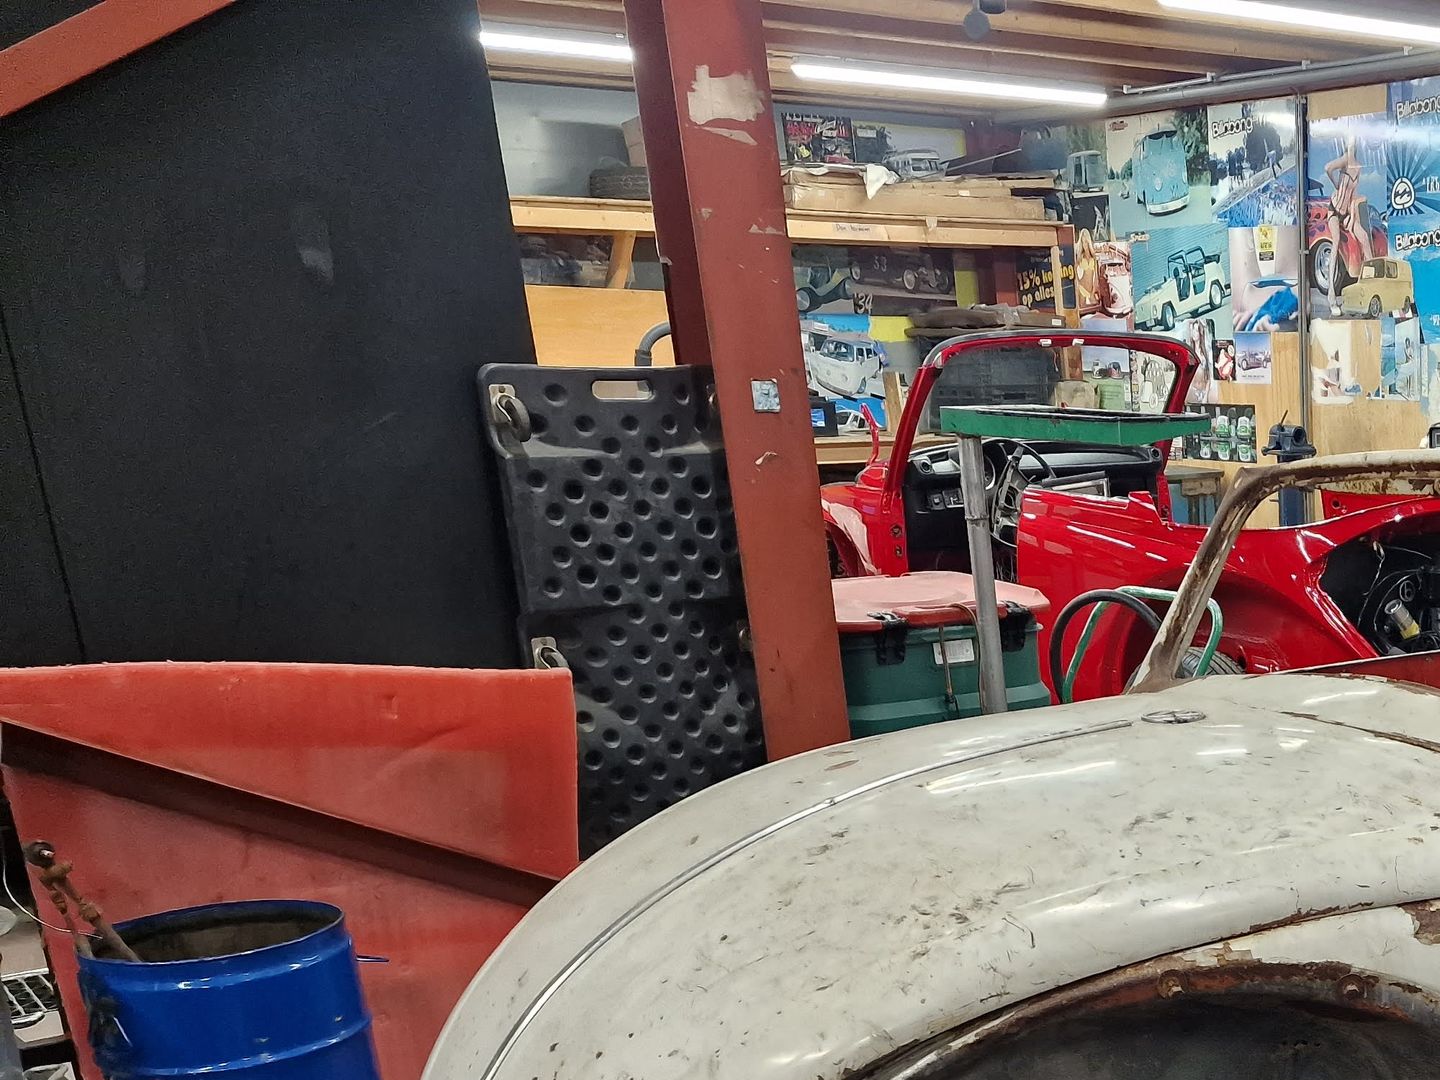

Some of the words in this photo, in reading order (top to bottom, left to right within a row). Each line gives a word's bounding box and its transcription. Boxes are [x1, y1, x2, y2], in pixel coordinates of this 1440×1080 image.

[1017, 268, 1041, 290] 15%
[1042, 264, 1075, 284] koing
[1022, 294, 1033, 308] op
[1035, 286, 1055, 302] alles
